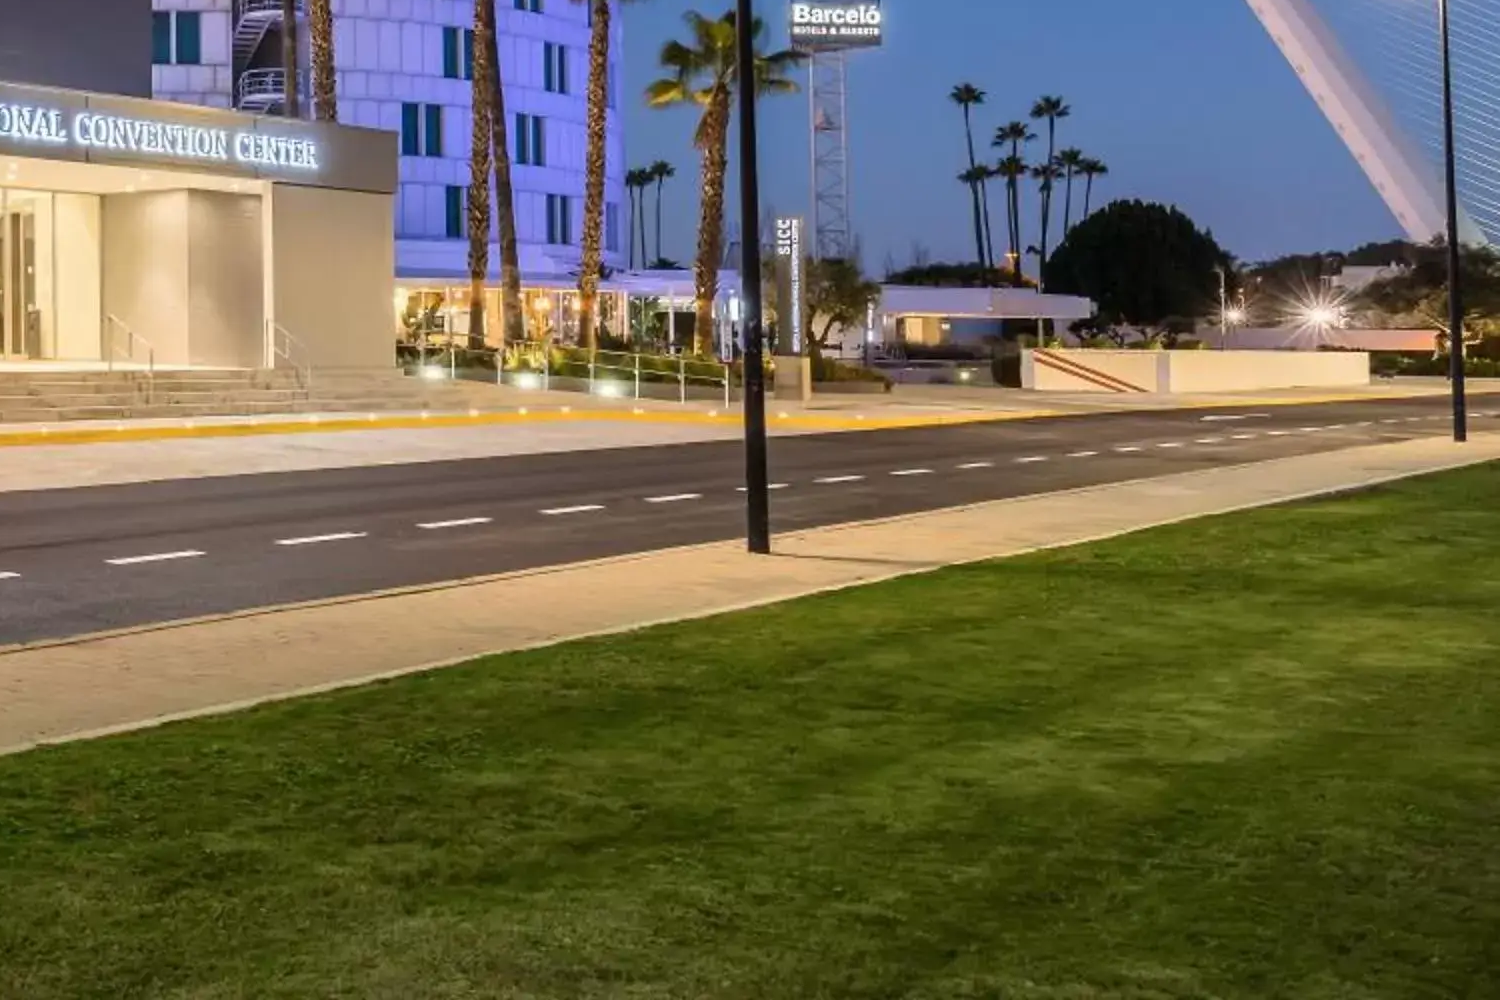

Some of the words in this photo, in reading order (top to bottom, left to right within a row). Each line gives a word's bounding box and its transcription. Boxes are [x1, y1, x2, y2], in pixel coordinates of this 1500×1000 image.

[792, 3, 881, 24] Barceló
[75, 113, 228, 161] CONVENTION
[235, 132, 318, 168] CENTER
[777, 219, 791, 255] SICC
